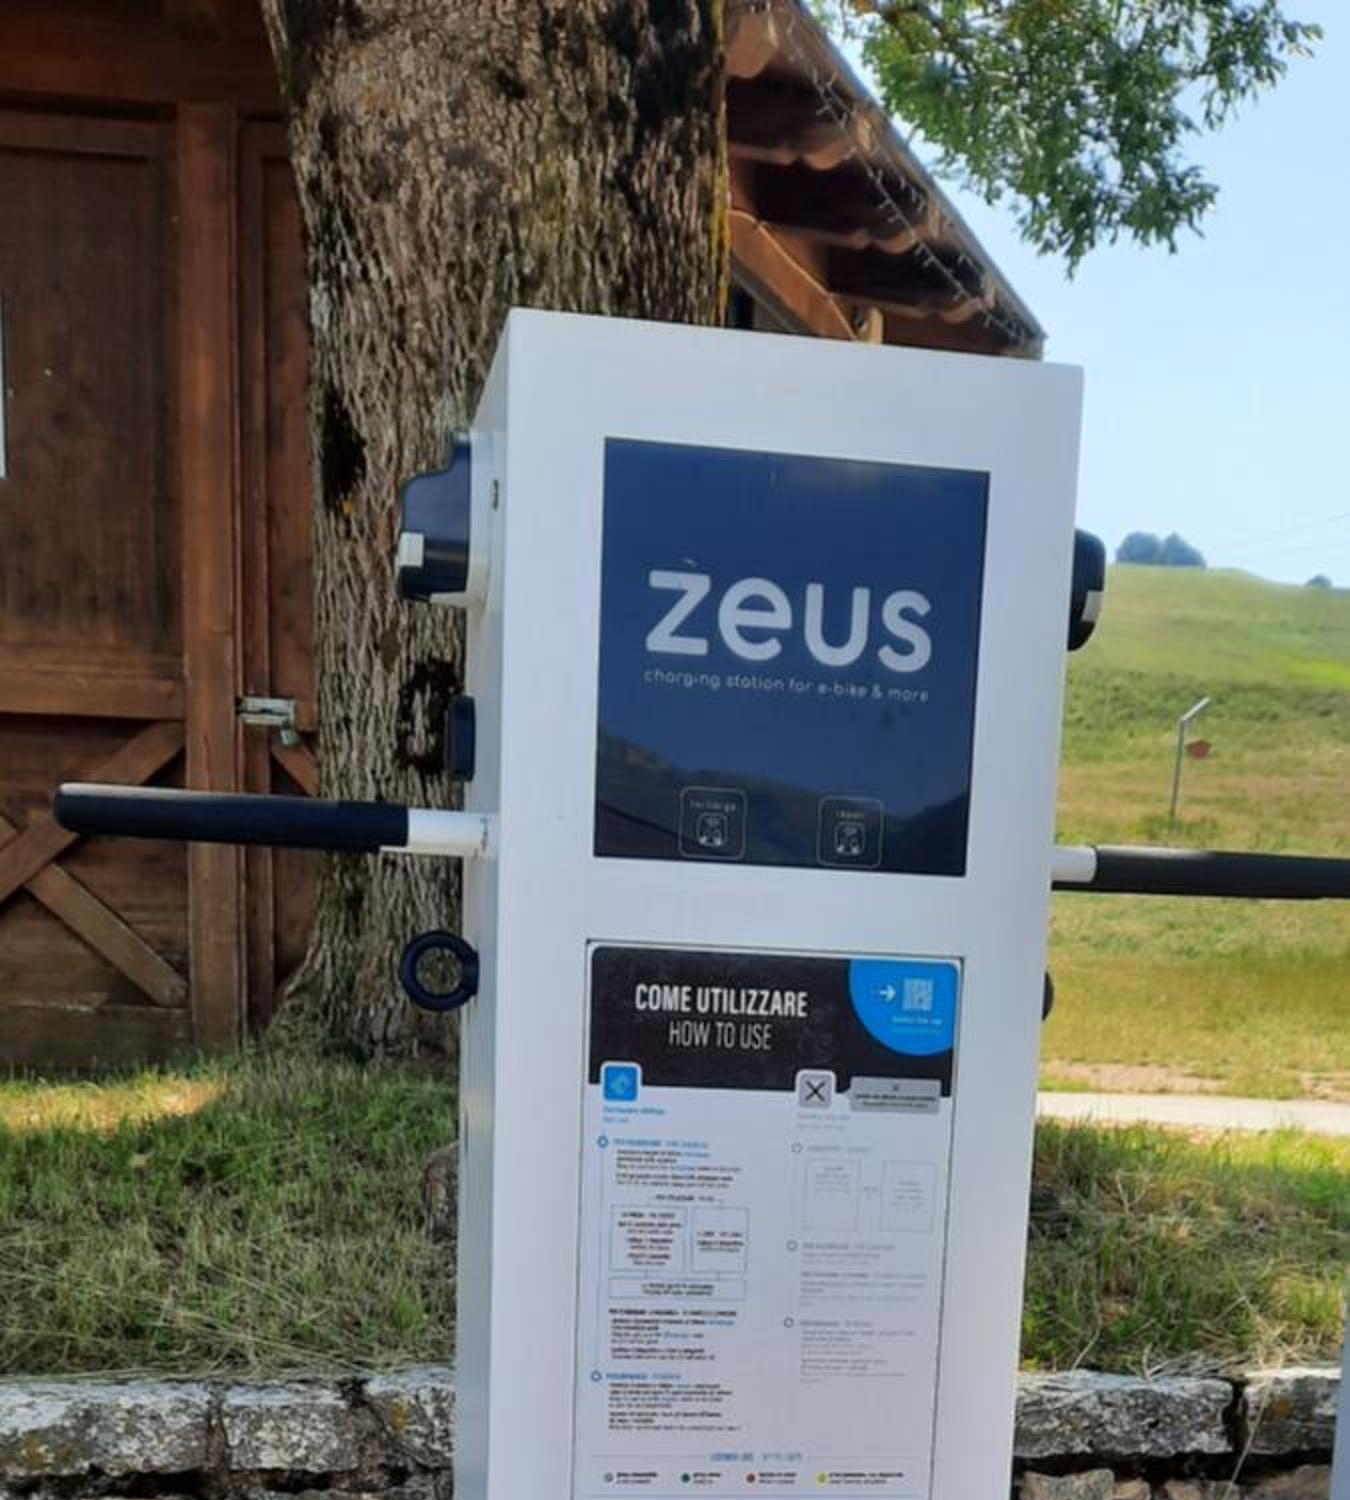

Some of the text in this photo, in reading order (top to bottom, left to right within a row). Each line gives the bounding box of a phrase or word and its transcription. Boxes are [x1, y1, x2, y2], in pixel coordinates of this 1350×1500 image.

[645, 569, 932, 673] zeus
[644, 669, 929, 702] charging station for e-bike & more
[635, 984, 809, 1018] COME UTILIZZARE
[669, 1020, 772, 1050] HOW TO USE
